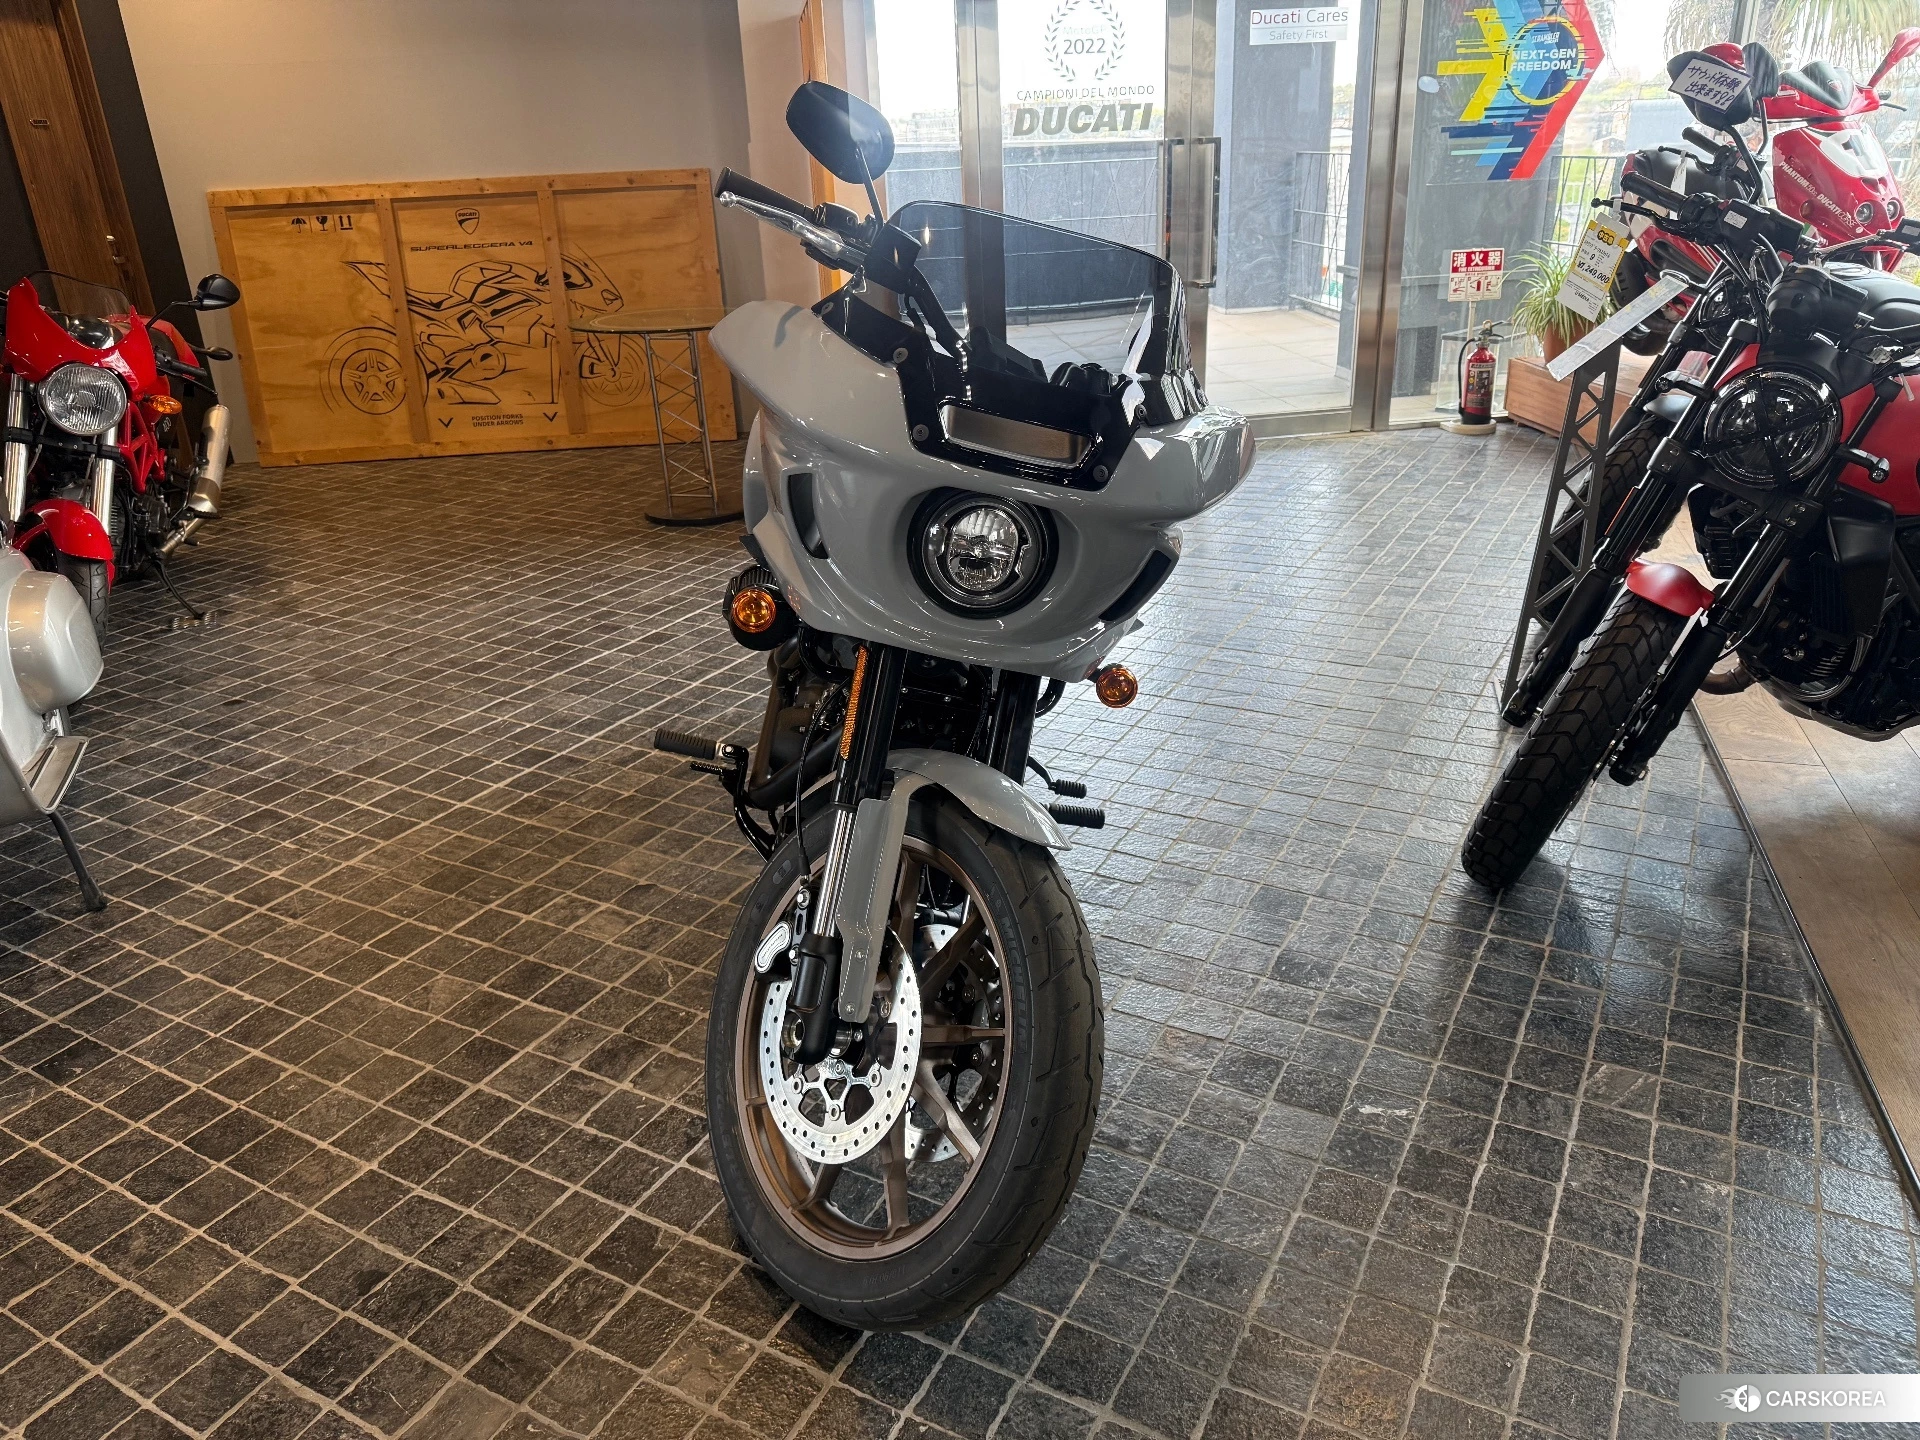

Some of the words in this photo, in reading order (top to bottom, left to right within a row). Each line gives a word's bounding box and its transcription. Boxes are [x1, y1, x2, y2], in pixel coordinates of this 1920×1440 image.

[1251, 10, 1301, 25] Ducati
[1306, 9, 1348, 23] Cares
[1269, 30, 1302, 41] Safety
[1305, 29, 1328, 39] First
[1063, 37, 1107, 55] 2022
[1512, 48, 1577, 60] NEXT-GEN
[1510, 60, 1572, 73] FREEDOM
[1687, 66, 1742, 93] サウンド体験
[1017, 88, 1078, 101] CAMPIONI
[1080, 87, 1105, 99] DEL
[1107, 85, 1155, 98] MONDO
[1012, 102, 1154, 137] DUCATI
[410, 241, 516, 253] SUPERLEGGERA
[1453, 251, 1501, 268] 消火器
[471, 414, 501, 422] POSITION
[1000, 917, 1028, 1054] MICHELIN
